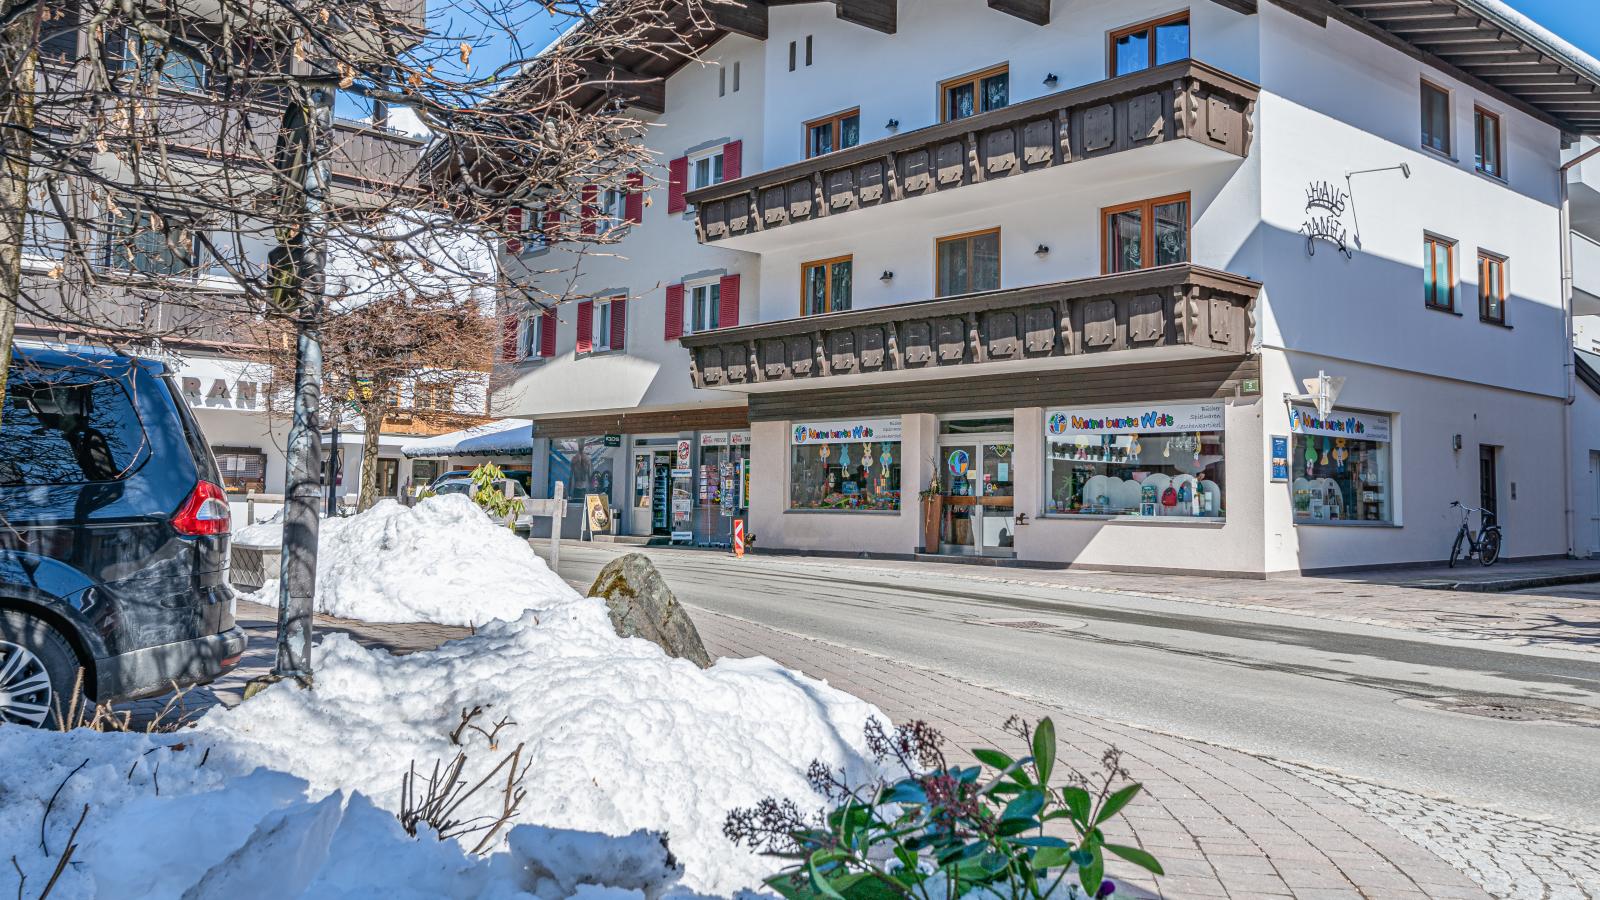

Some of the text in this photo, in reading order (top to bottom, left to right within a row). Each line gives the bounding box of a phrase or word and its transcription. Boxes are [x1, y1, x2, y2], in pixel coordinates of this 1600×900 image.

[1305, 180, 1349, 217] HAUS
[1071, 411, 1174, 429] Meine bunte Welt
